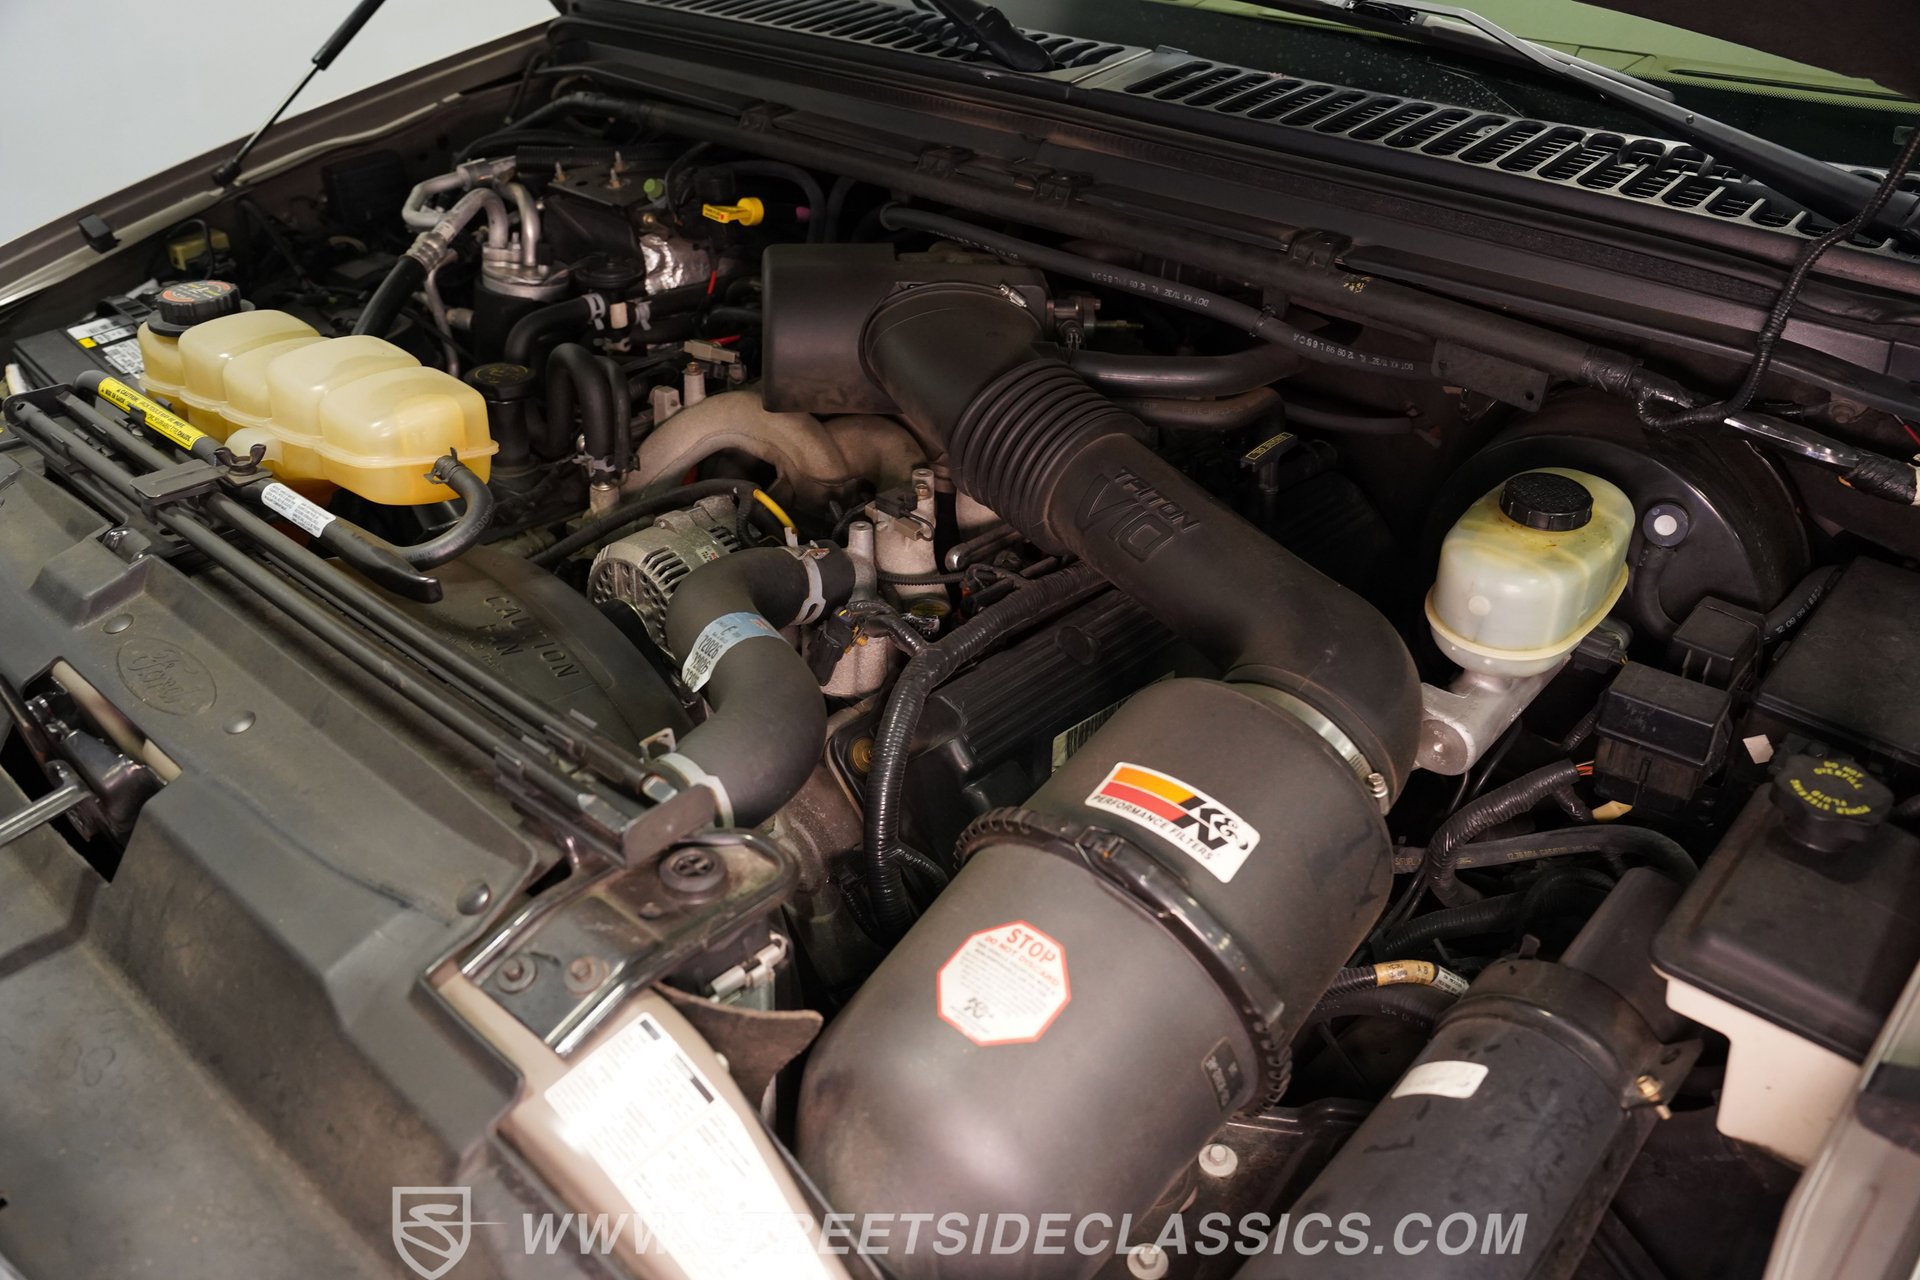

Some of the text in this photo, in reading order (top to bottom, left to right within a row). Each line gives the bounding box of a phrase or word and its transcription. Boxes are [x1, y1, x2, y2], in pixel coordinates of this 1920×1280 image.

[1075, 474, 1175, 562] V10
[1115, 466, 1200, 533] TRITON
[1092, 795, 1214, 861] PERFORMANCE FILTERS
[1007, 928, 1057, 962] STOP
